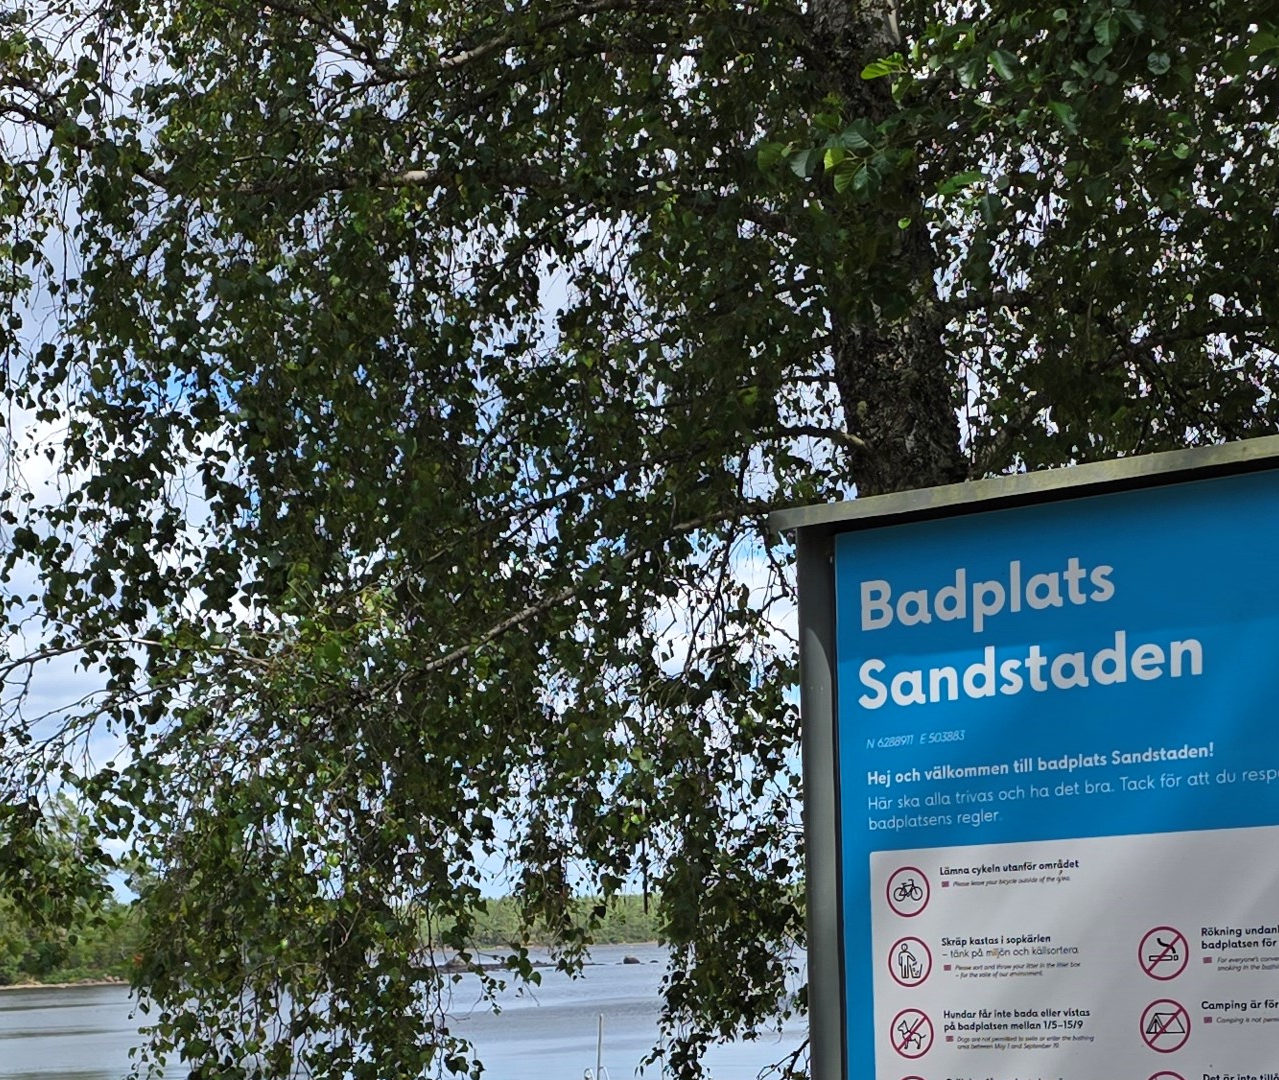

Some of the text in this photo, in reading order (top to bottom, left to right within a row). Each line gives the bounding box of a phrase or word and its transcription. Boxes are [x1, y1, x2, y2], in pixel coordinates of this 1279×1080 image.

[860, 557, 1115, 632] Badplats
[857, 631, 1204, 710] Sandstaden
[866, 739, 874, 748] N
[921, 734, 926, 744] E
[929, 730, 965, 743] 503883
[867, 742, 1213, 787] Hej och välkommen till badplats Sandstaden!
[868, 796, 891, 810] Här
[897, 794, 920, 808] ska
[925, 792, 951, 806] alla
[956, 790, 993, 804] trivas
[999, 786, 1025, 801] och
[1030, 785, 1049, 798] ha
[1055, 782, 1079, 796] det
[1085, 780, 1115, 794] bra.
[1120, 776, 1155, 791] Tack
[1160, 773, 1182, 788] för
[1187, 771, 1209, 786] att
[1216, 769, 1236, 783] du
[869, 813, 952, 831] badplatsens
[940, 860, 1079, 876] Lämna cykeln utanför området
[1201, 927, 1242, 937] Rökning
[942, 934, 1051, 947] Skräp kastas i sopkärlen
[1202, 940, 1259, 950] badplatsen
[1262, 938, 1277, 947] för
[951, 950, 969, 958] tänk
[972, 949, 983, 959] på
[1032, 946, 1078, 955] källsortera
[1201, 1000, 1247, 1011] Camping
[1250, 1001, 1262, 1009] är
[944, 1008, 1090, 1019] Hundar får inte bada eller vistas
[944, 1022, 955, 1032] på
[958, 1021, 1008, 1032] badplatsen
[1011, 1022, 1041, 1030] mellan
